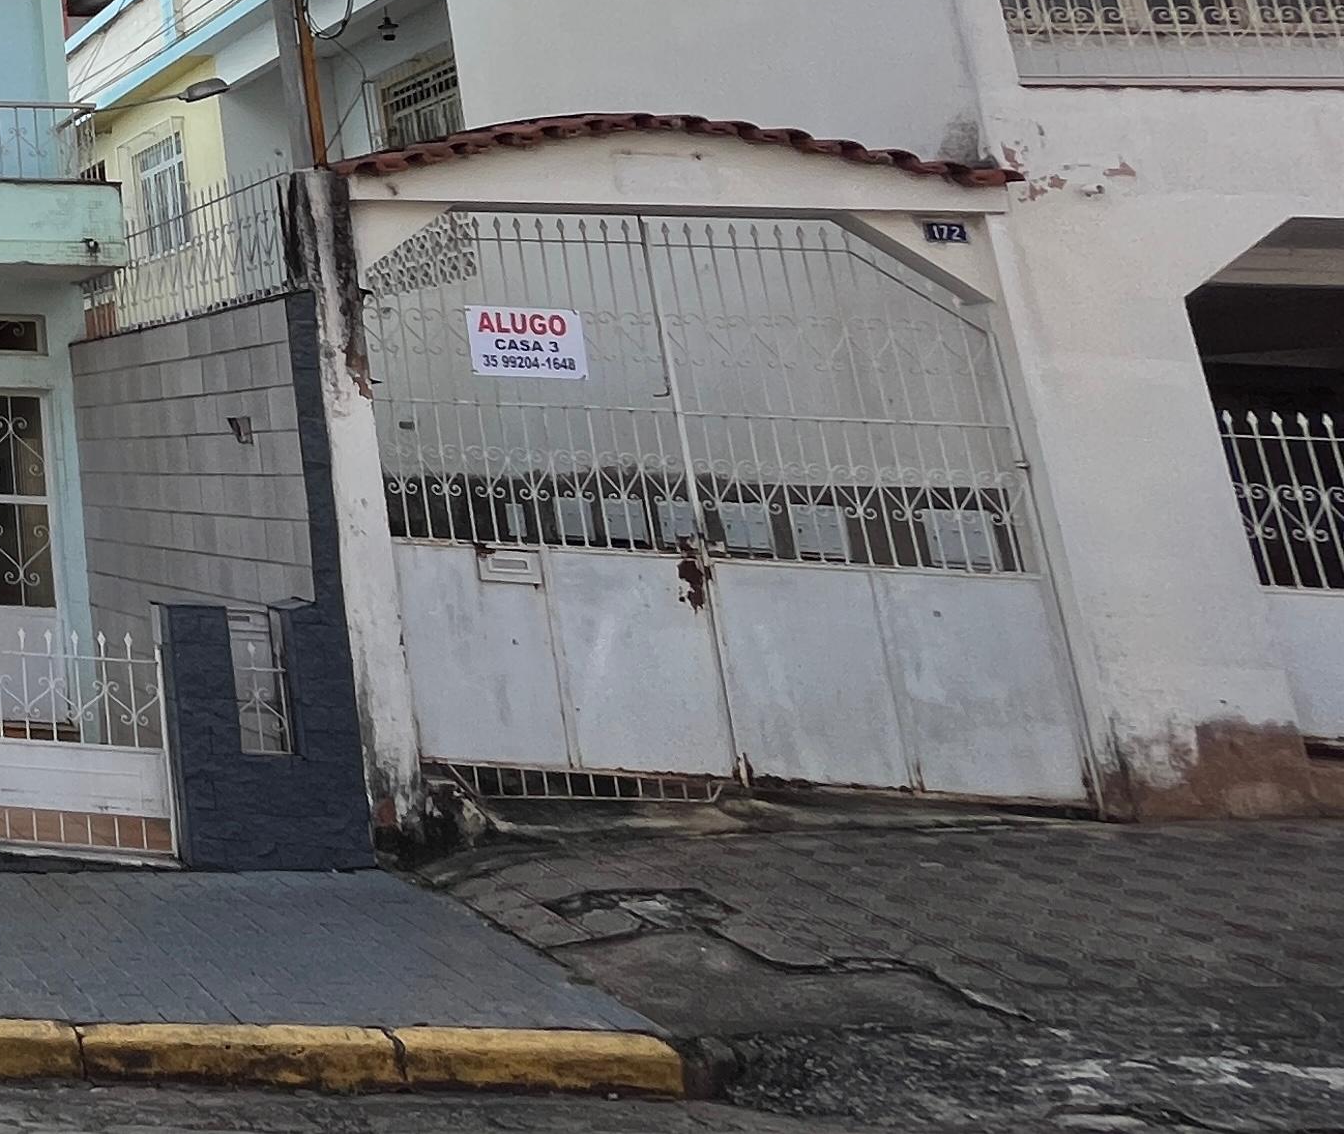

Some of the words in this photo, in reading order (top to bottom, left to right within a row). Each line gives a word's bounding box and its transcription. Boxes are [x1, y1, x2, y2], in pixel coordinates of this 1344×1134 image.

[932, 225, 962, 240] 172
[478, 312, 567, 336] ALUGO
[494, 338, 544, 352] CASA
[549, 341, 560, 353] 3
[482, 354, 498, 368] 35
